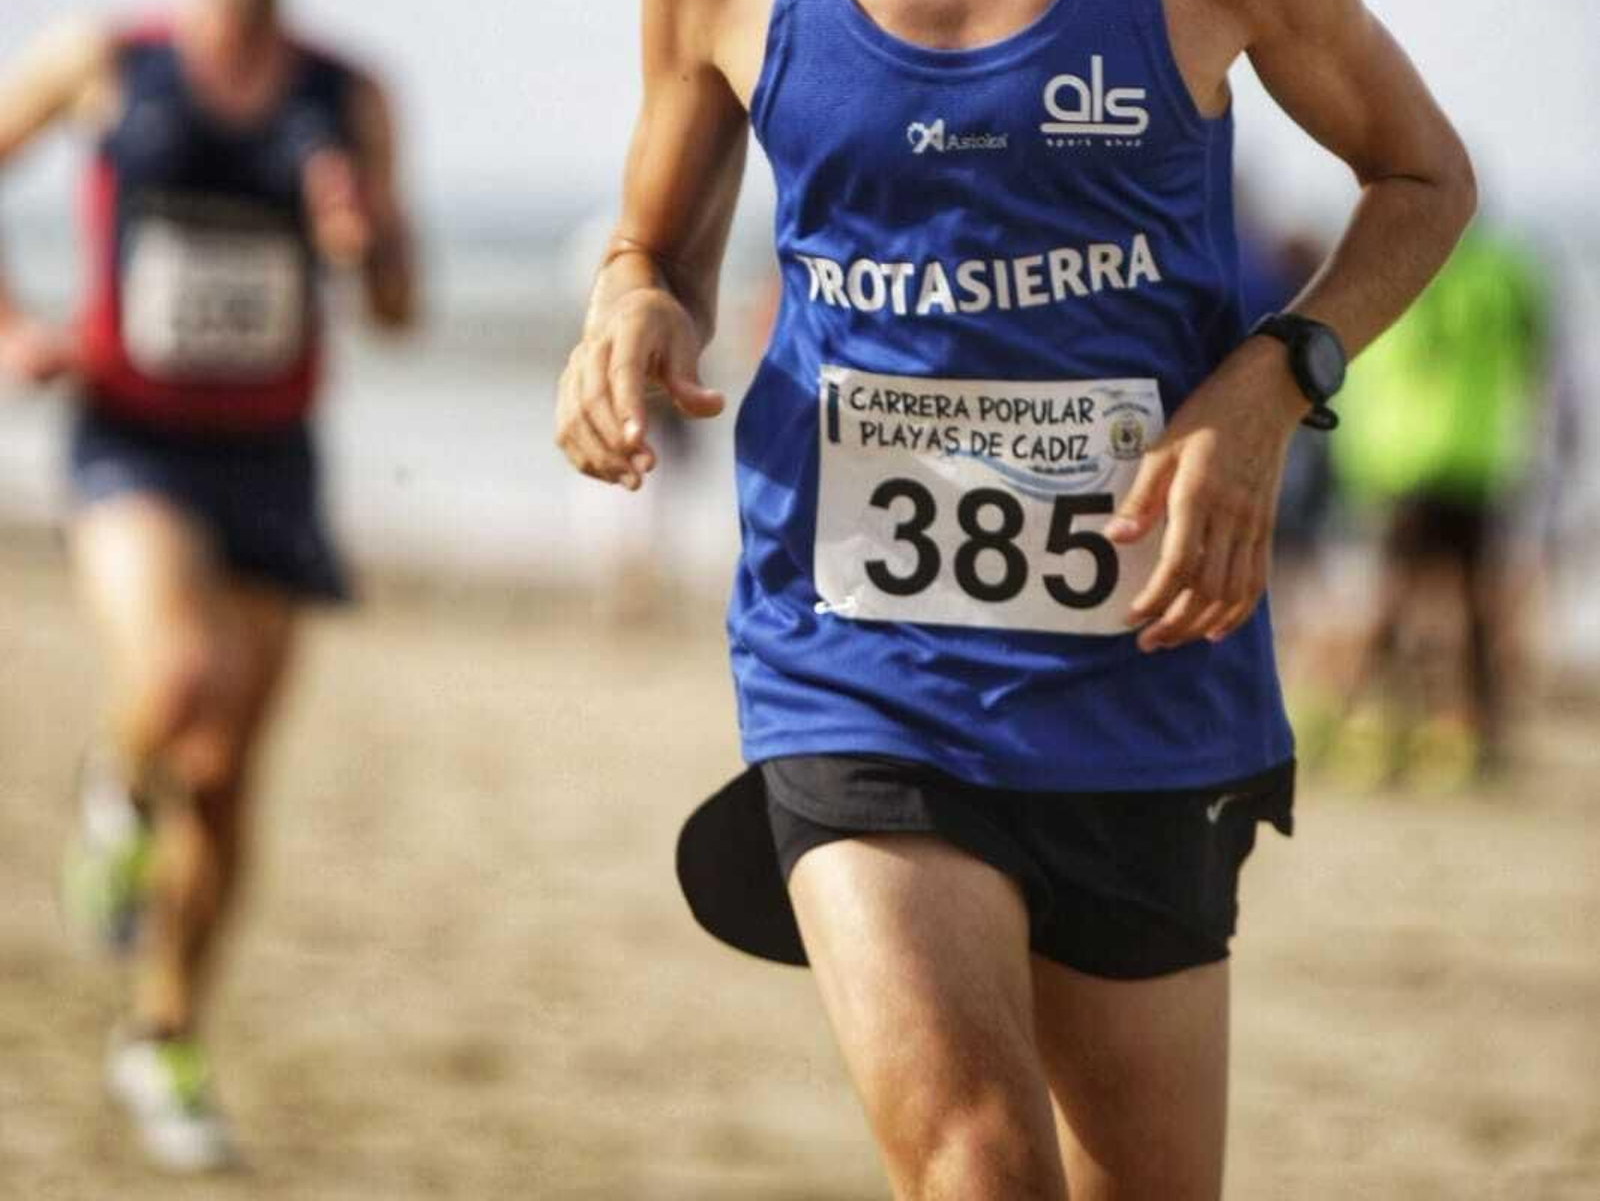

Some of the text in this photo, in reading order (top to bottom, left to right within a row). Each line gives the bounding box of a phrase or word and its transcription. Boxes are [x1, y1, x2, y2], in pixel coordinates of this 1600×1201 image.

[1041, 54, 1148, 134] als
[850, 386, 971, 420] CARRERA
[979, 396, 1095, 425] POPULAR
[860, 420, 1089, 462] PLAYAS DE CADIZ
[864, 477, 1120, 610] 385
